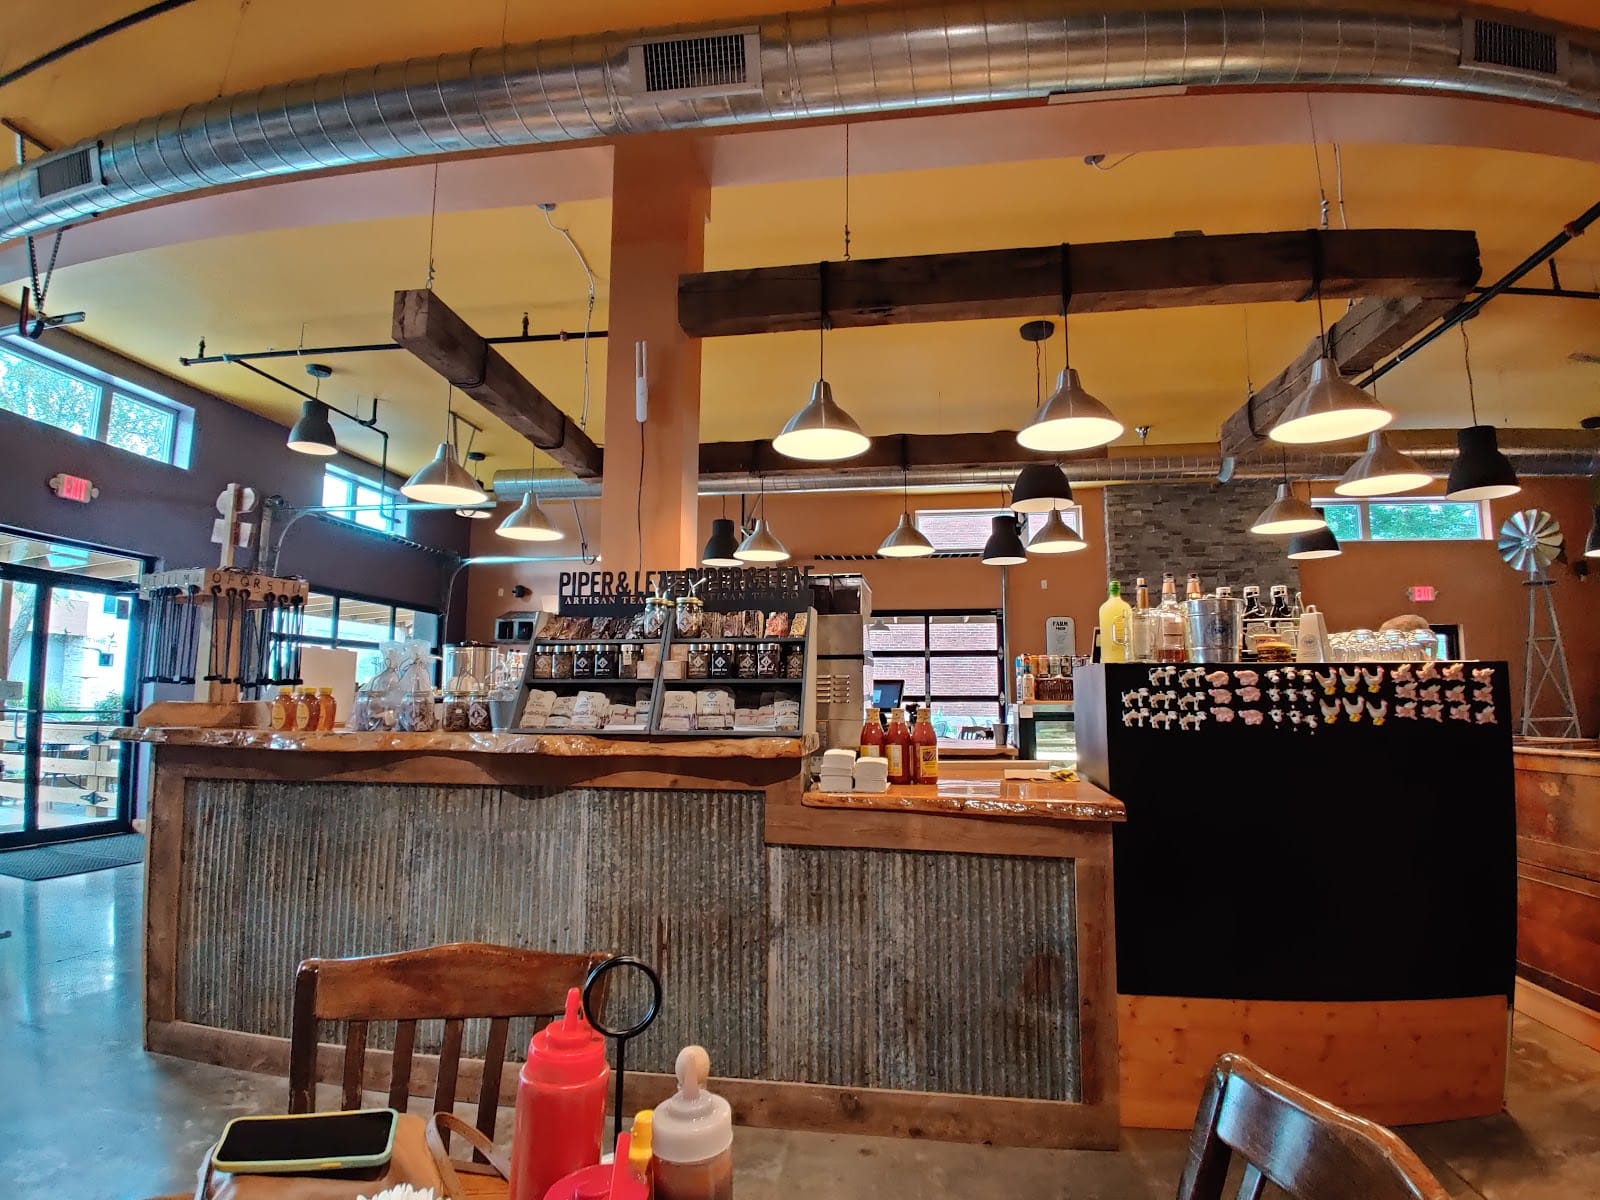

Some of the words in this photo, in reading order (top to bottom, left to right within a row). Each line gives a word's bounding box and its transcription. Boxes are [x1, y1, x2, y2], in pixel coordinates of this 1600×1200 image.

[63, 475, 88, 501] EXIT
[564, 596, 616, 605] ARTISAN
[622, 596, 645, 605] TEA
